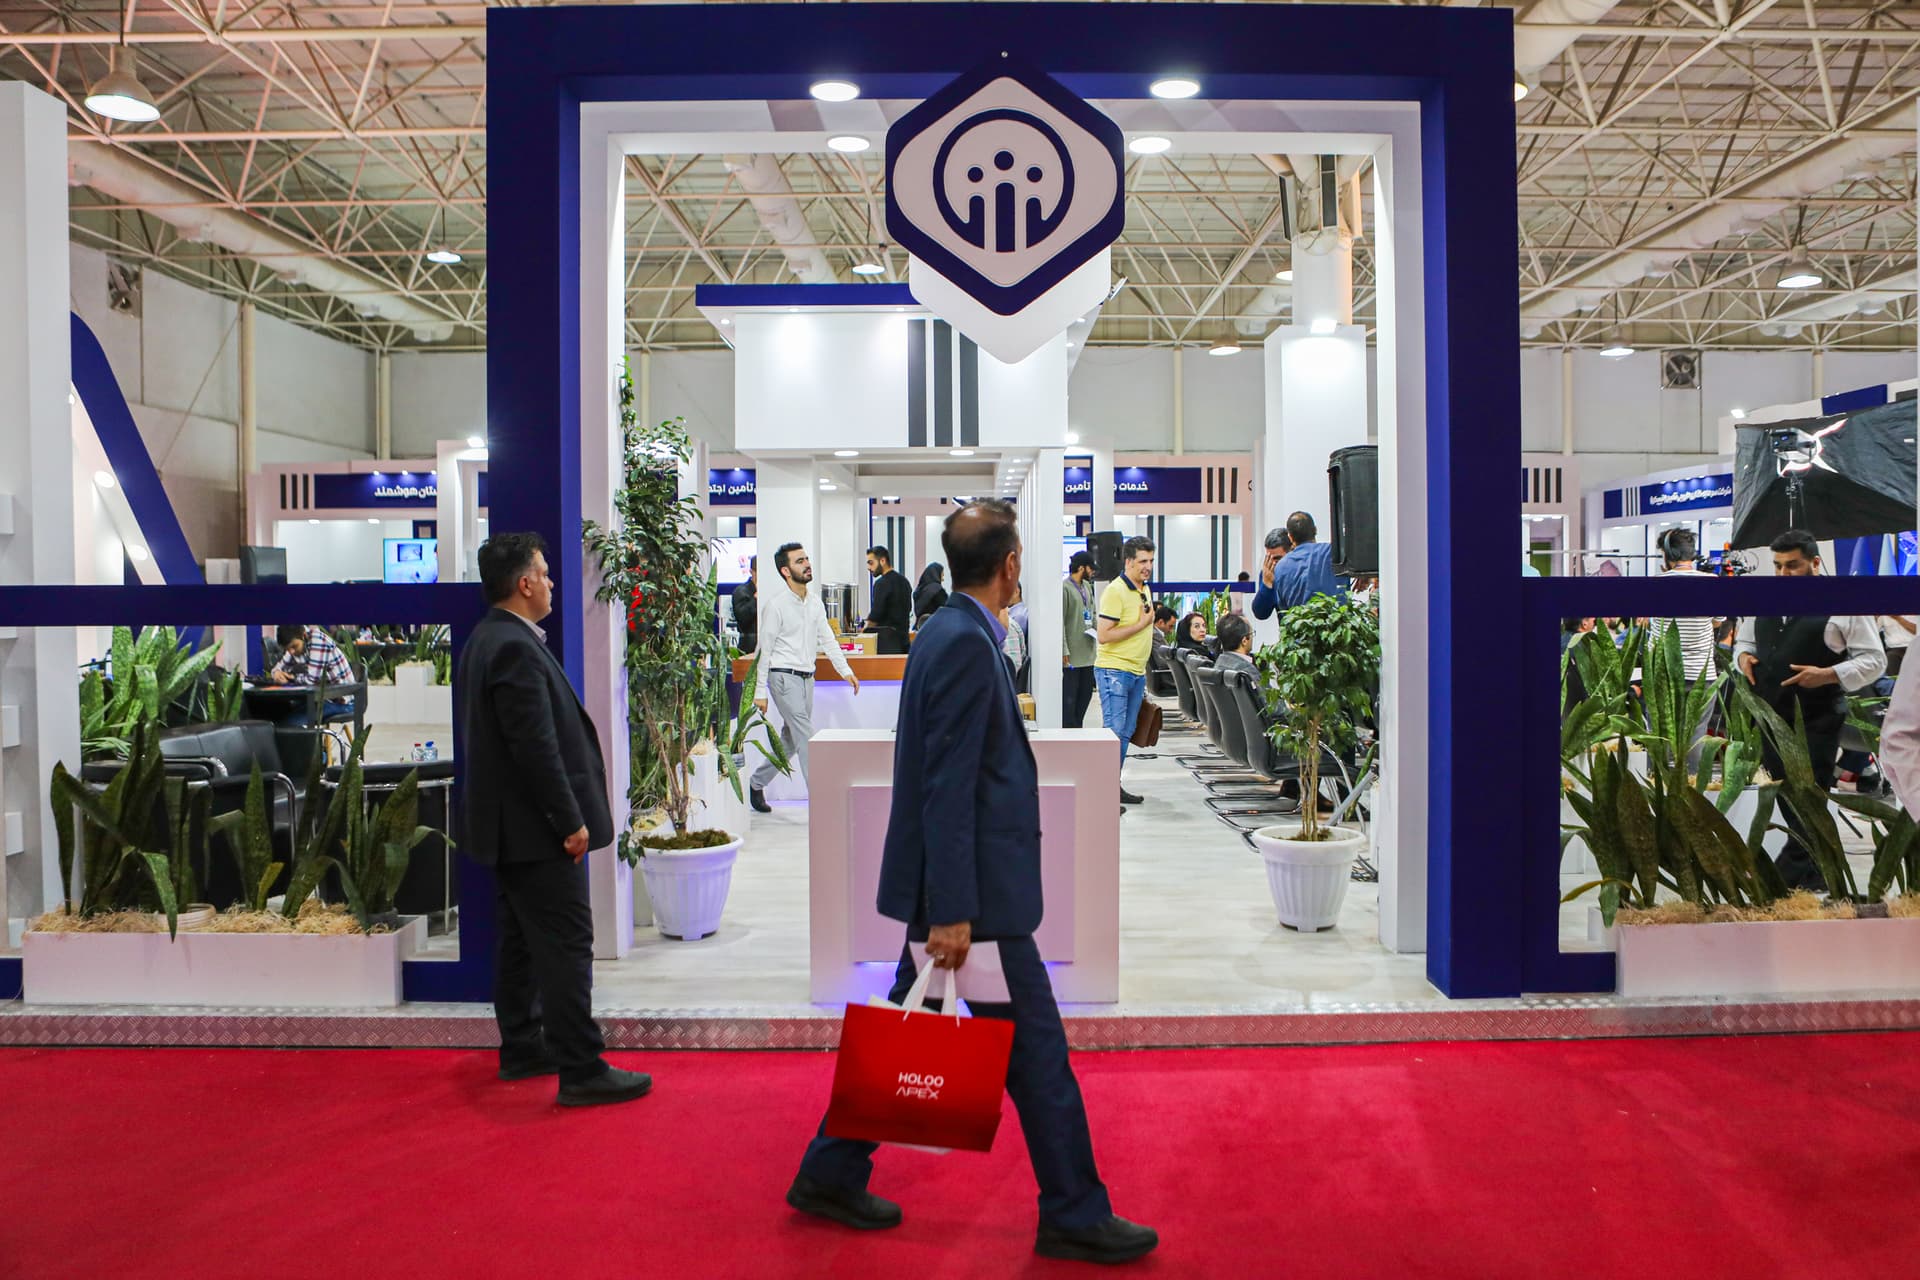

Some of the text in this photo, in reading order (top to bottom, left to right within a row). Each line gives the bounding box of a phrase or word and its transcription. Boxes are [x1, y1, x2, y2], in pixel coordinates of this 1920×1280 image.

[374, 484, 418, 498] هوشمند
[1118, 481, 1149, 491] خدمات
[898, 1071, 944, 1088] HOLOO
[896, 1085, 940, 1100] APEX
